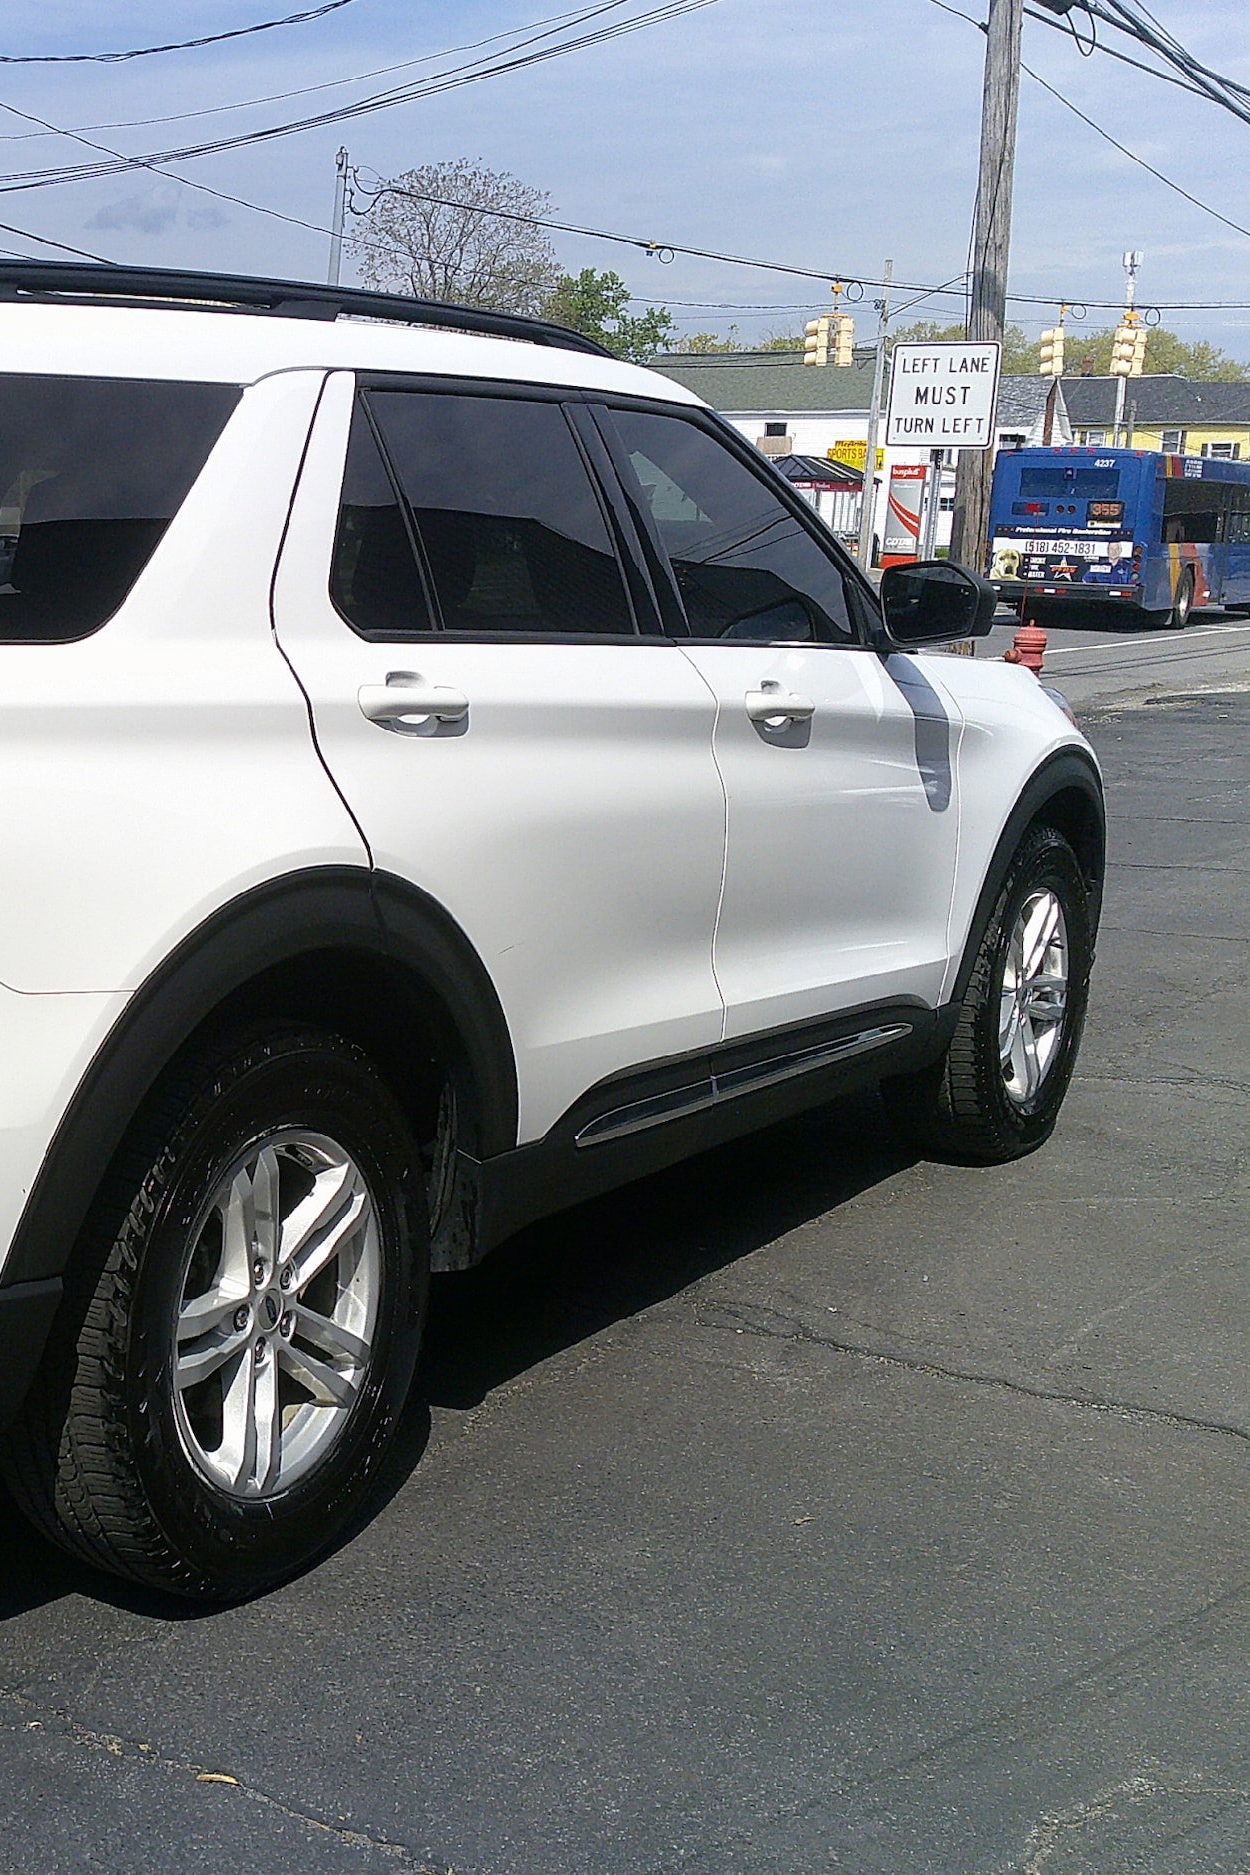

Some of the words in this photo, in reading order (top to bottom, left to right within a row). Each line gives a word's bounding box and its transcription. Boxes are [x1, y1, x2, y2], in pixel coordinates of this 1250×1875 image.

[902, 358, 940, 373] LEFT
[949, 357, 990, 373] LANE
[914, 386, 971, 405] MUST
[895, 418, 934, 434] TURN
[942, 418, 984, 434] LEFT
[827, 448, 857, 459] SPORTS
[1094, 459, 1116, 468] 4237
[1051, 543, 1096, 555] 452-1831
